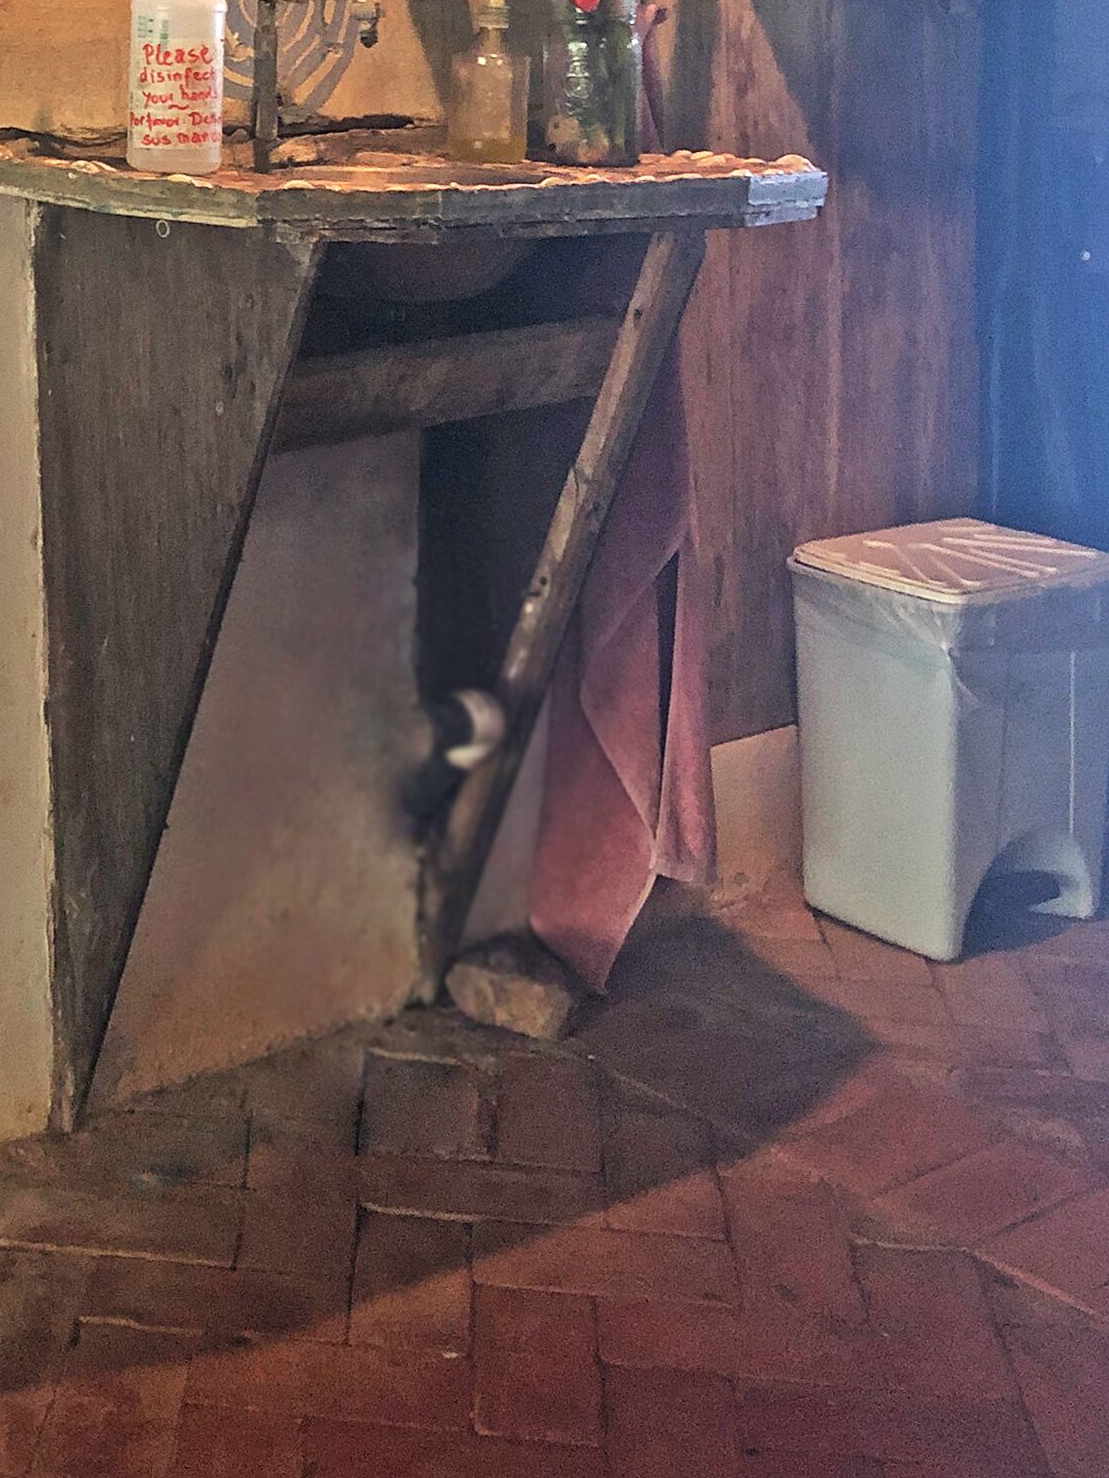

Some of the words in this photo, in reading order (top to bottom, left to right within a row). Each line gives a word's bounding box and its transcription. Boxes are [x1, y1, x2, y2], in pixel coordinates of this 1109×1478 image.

[142, 43, 213, 66] Please
[139, 67, 216, 89] disinfect
[142, 91, 174, 109] your
[142, 133, 172, 146] sus
